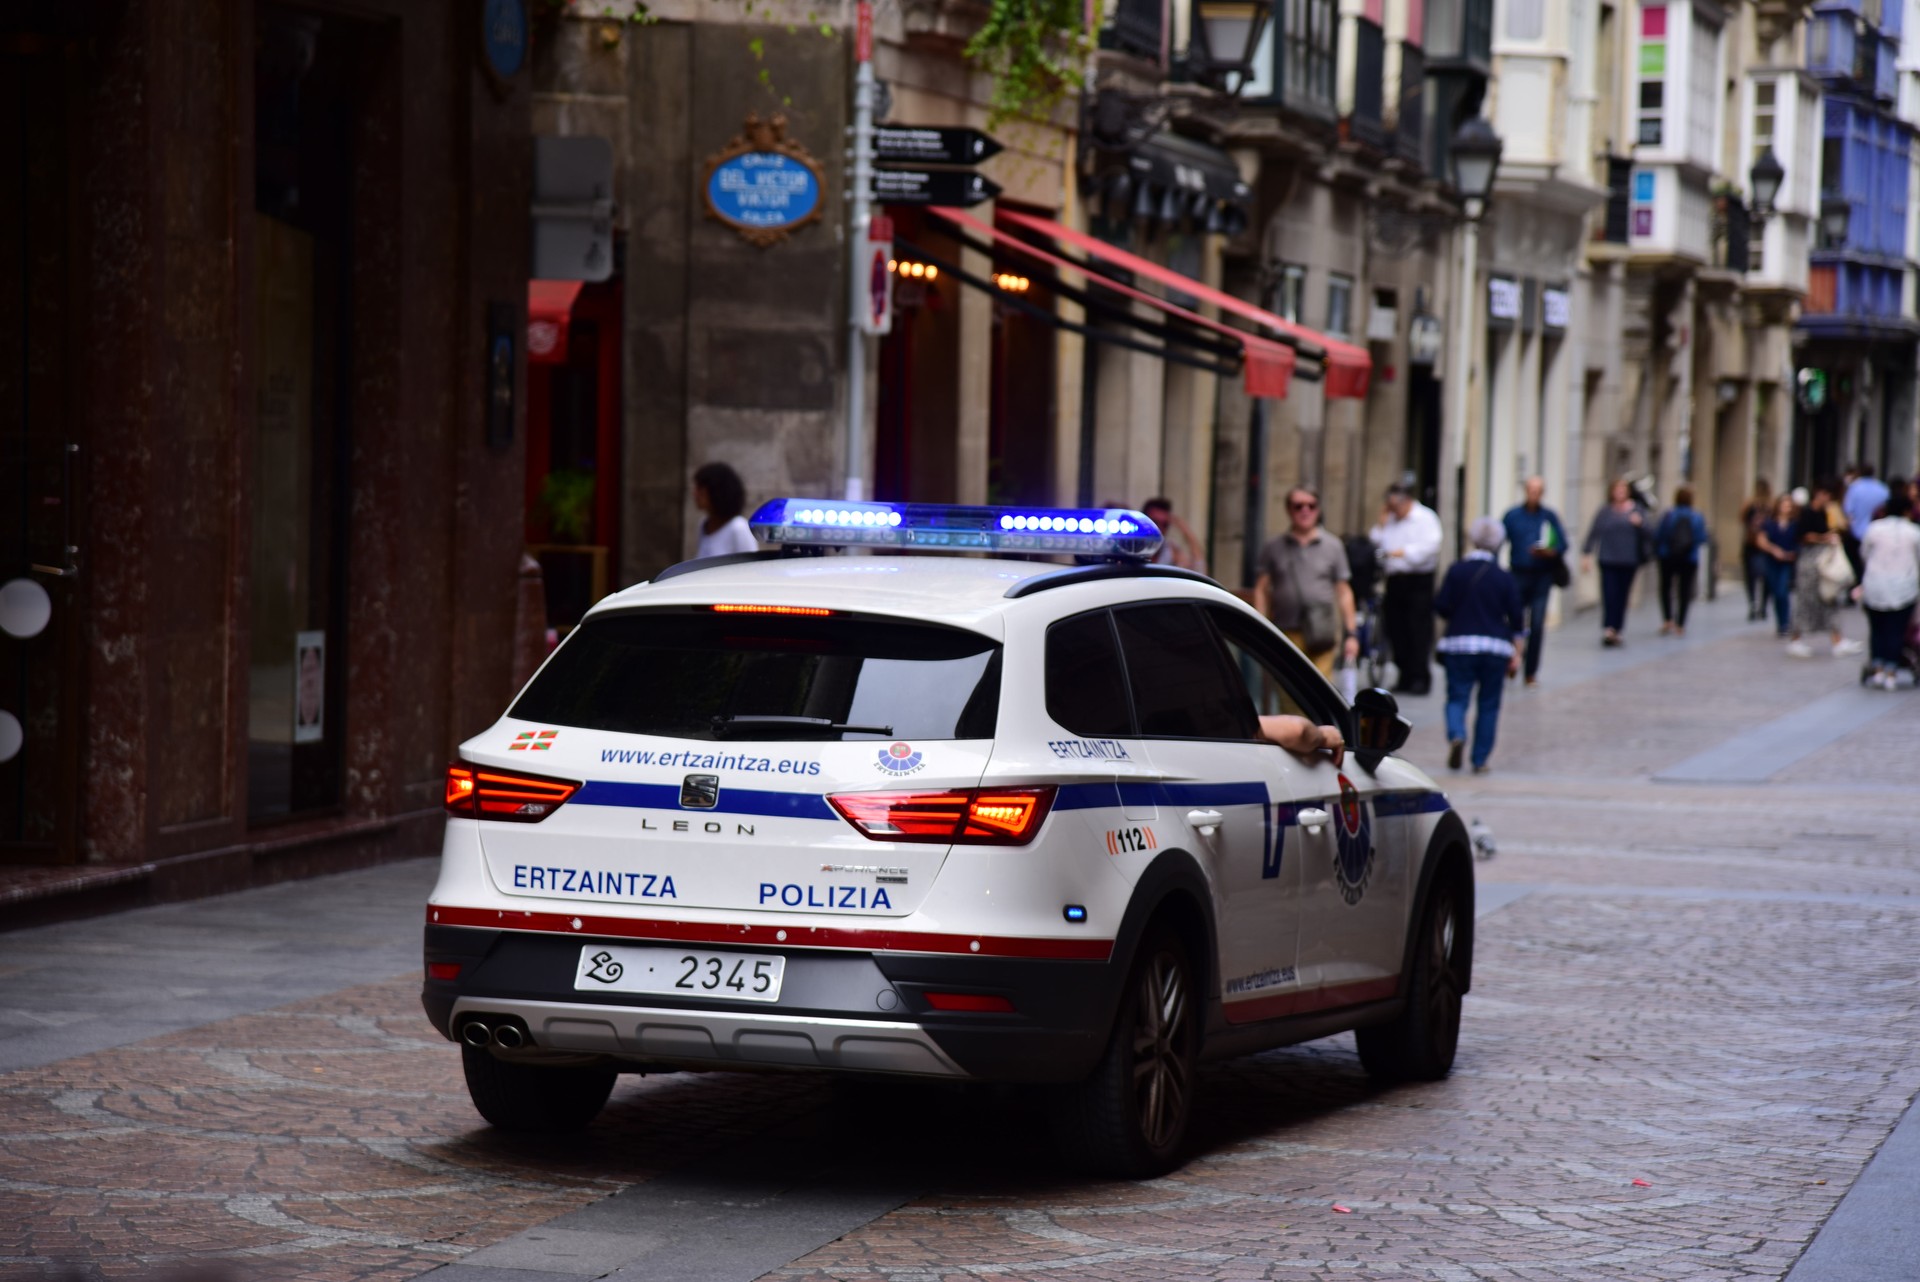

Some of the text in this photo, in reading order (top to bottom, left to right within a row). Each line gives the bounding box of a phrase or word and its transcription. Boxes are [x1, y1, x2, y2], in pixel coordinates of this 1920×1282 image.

[601, 749, 821, 776] www.ertzaintza.eus
[1048, 741, 1131, 758] ERTZAINTZA
[641, 818, 755, 836] LEON
[1118, 827, 1147, 853] 112
[514, 864, 677, 898] ERTZAINTZA
[759, 883, 892, 909] POLIZIA
[675, 955, 772, 993] 2345
